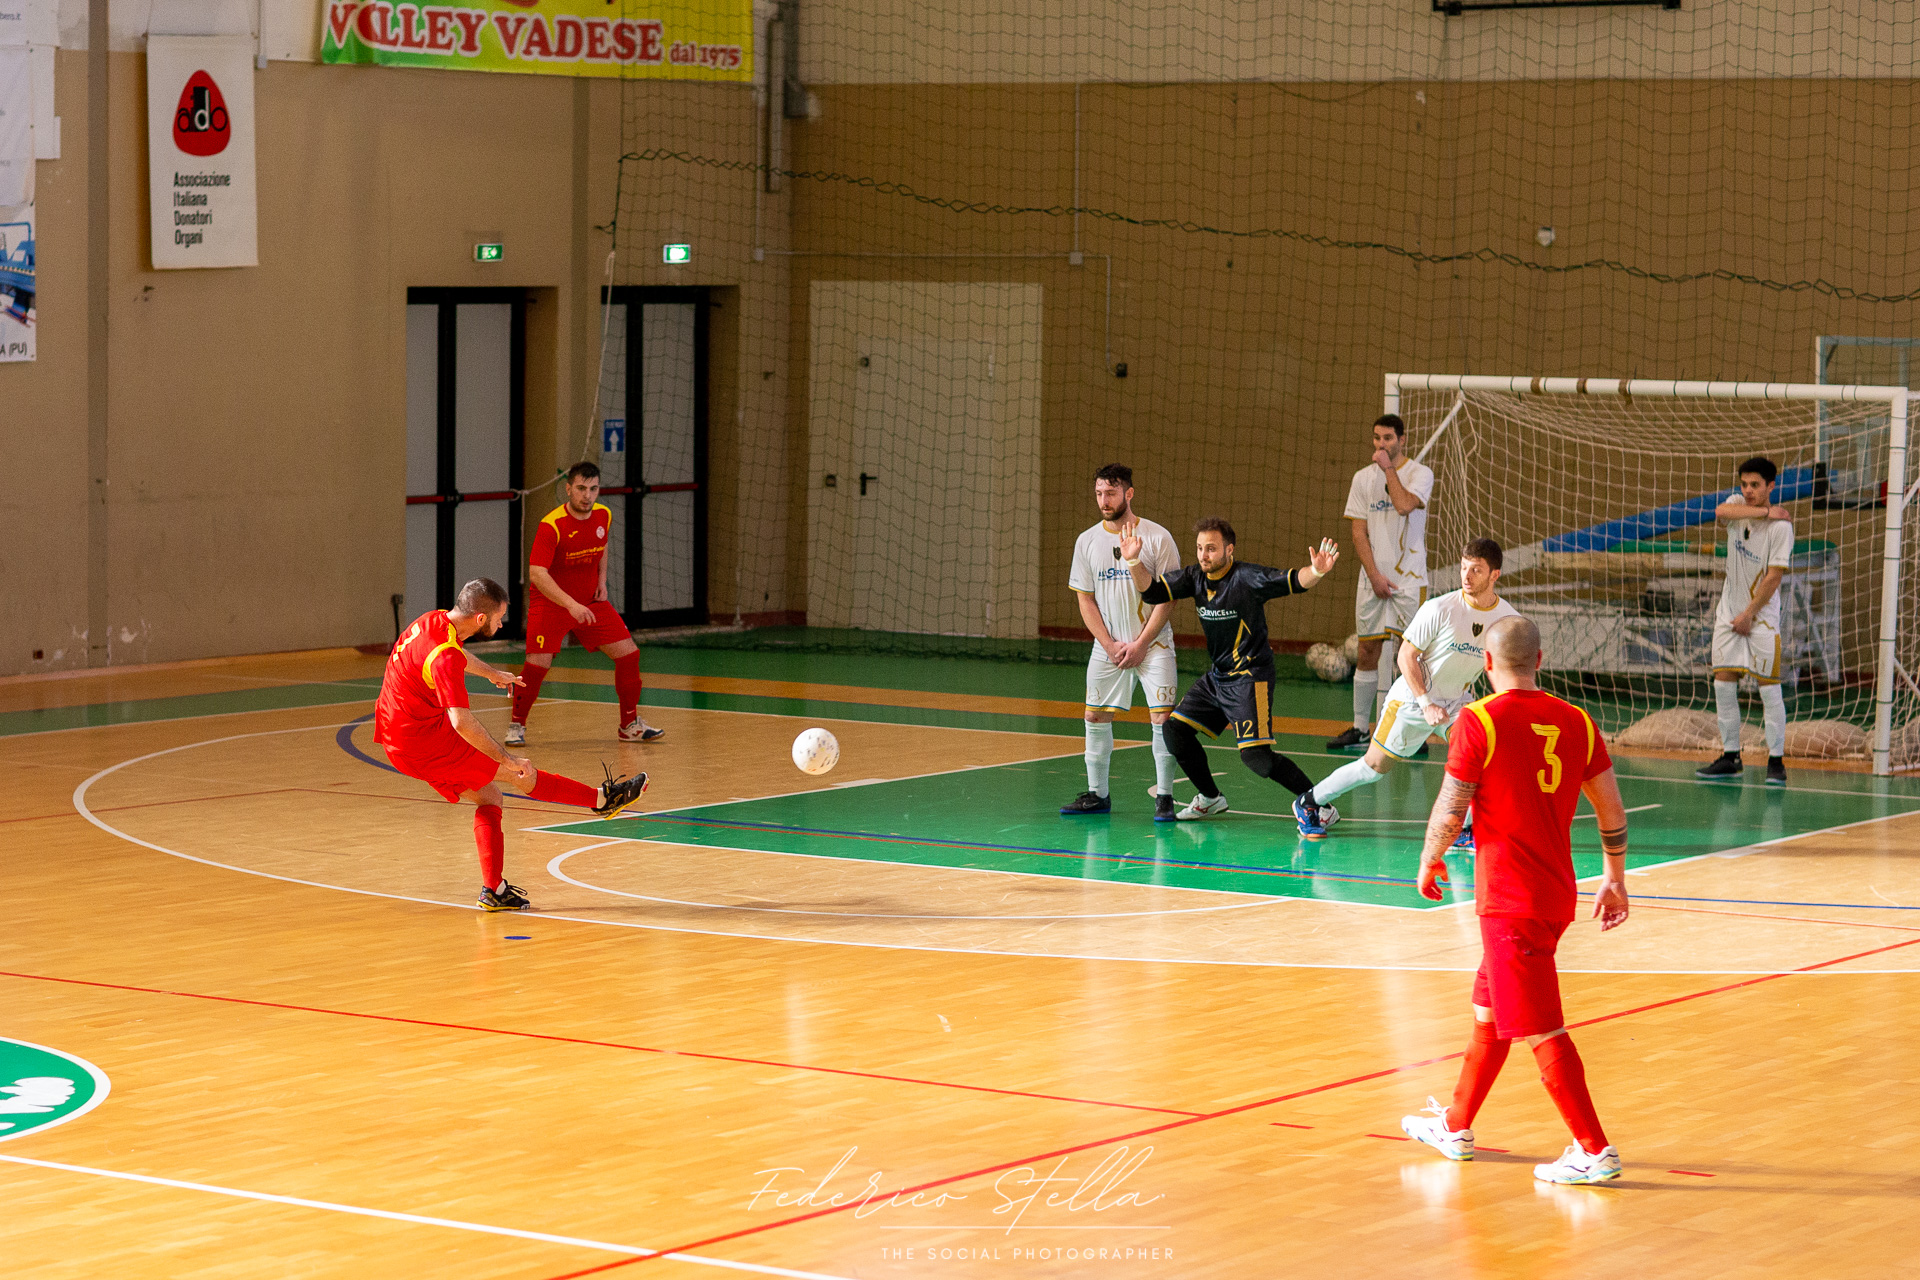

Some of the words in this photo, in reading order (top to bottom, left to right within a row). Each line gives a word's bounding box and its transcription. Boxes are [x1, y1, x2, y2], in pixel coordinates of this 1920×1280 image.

[494, 15, 663, 61] VADESE
[670, 43, 696, 63] dal
[700, 47, 740, 66] 1975
[173, 171, 230, 188] Associazione
[173, 191, 207, 207] Italiana
[174, 209, 212, 226] Donatori
[174, 229, 203, 248] Organi
[537, 635, 545, 649] 9
[1156, 685, 1177, 703] 69
[1234, 719, 1255, 739] 12
[1530, 722, 1563, 794] 3
